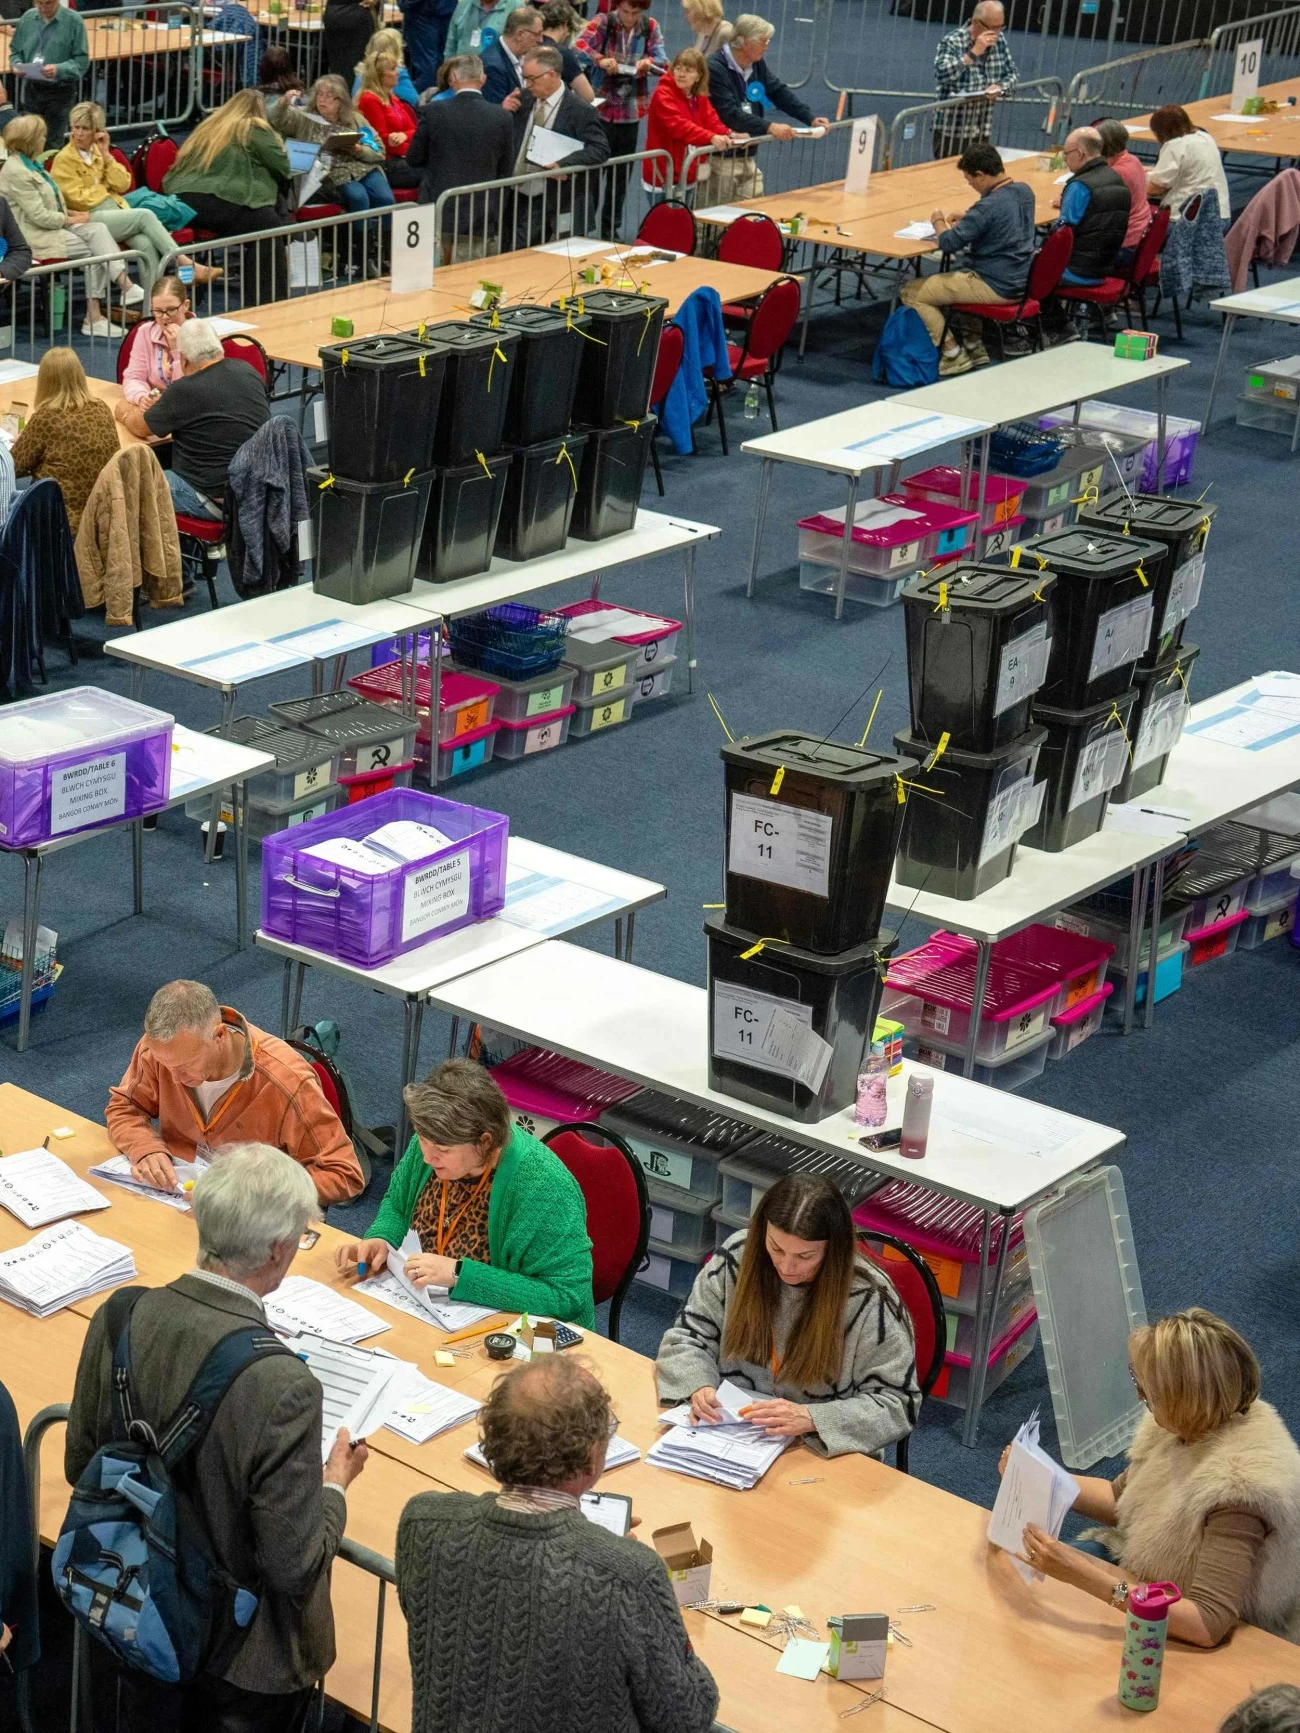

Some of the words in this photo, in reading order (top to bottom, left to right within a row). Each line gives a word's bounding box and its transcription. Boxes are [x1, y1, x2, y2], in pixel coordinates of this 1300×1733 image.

[1241, 51, 1256, 75] 10
[858, 130, 867, 154] 9
[407, 221, 420, 248] 8
[63, 761, 110, 781] BWRDD/TABLE
[62, 783, 84, 794] BLWCH
[85, 773, 116, 787] CYMYSGU
[70, 792, 94, 804] MIXING
[95, 788, 108, 797] BOX
[59, 808, 81, 820] BANGOR
[83, 802, 103, 812] CONWY
[754, 820, 779, 836] FC-
[758, 844, 772, 859] 11
[416, 861, 455, 884] BWRDD/TABLE
[414, 885, 434, 898] BLWCH
[435, 872, 462, 889] CYMYSGU
[420, 895, 442, 909] MIXING
[443, 889, 455, 899] BOX
[410, 913, 430, 926] BANGOR
[735, 1007, 759, 1023] FC-
[739, 1029, 752, 1044] 11
